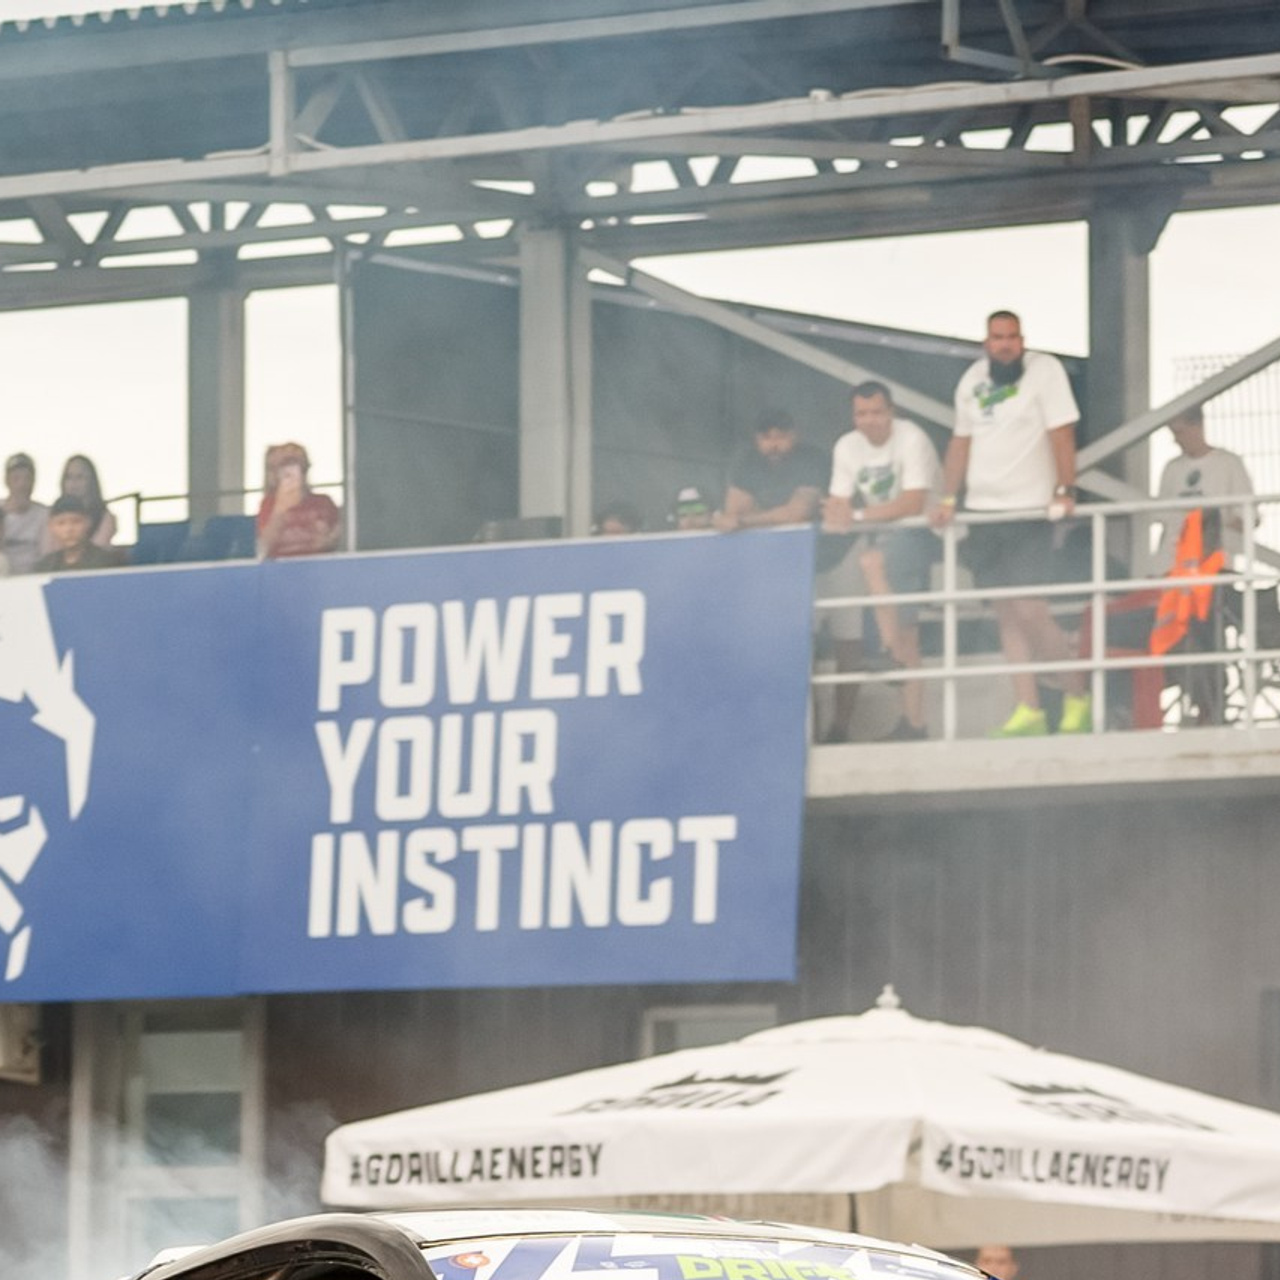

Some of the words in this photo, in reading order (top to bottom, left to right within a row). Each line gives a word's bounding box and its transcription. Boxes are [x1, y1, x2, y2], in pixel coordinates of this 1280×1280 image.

[317, 590, 646, 712] POWER
[315, 709, 557, 823] YOUR
[308, 815, 737, 938] INSTINCT
[350, 1143, 602, 1187] #GORILLAENERGY
